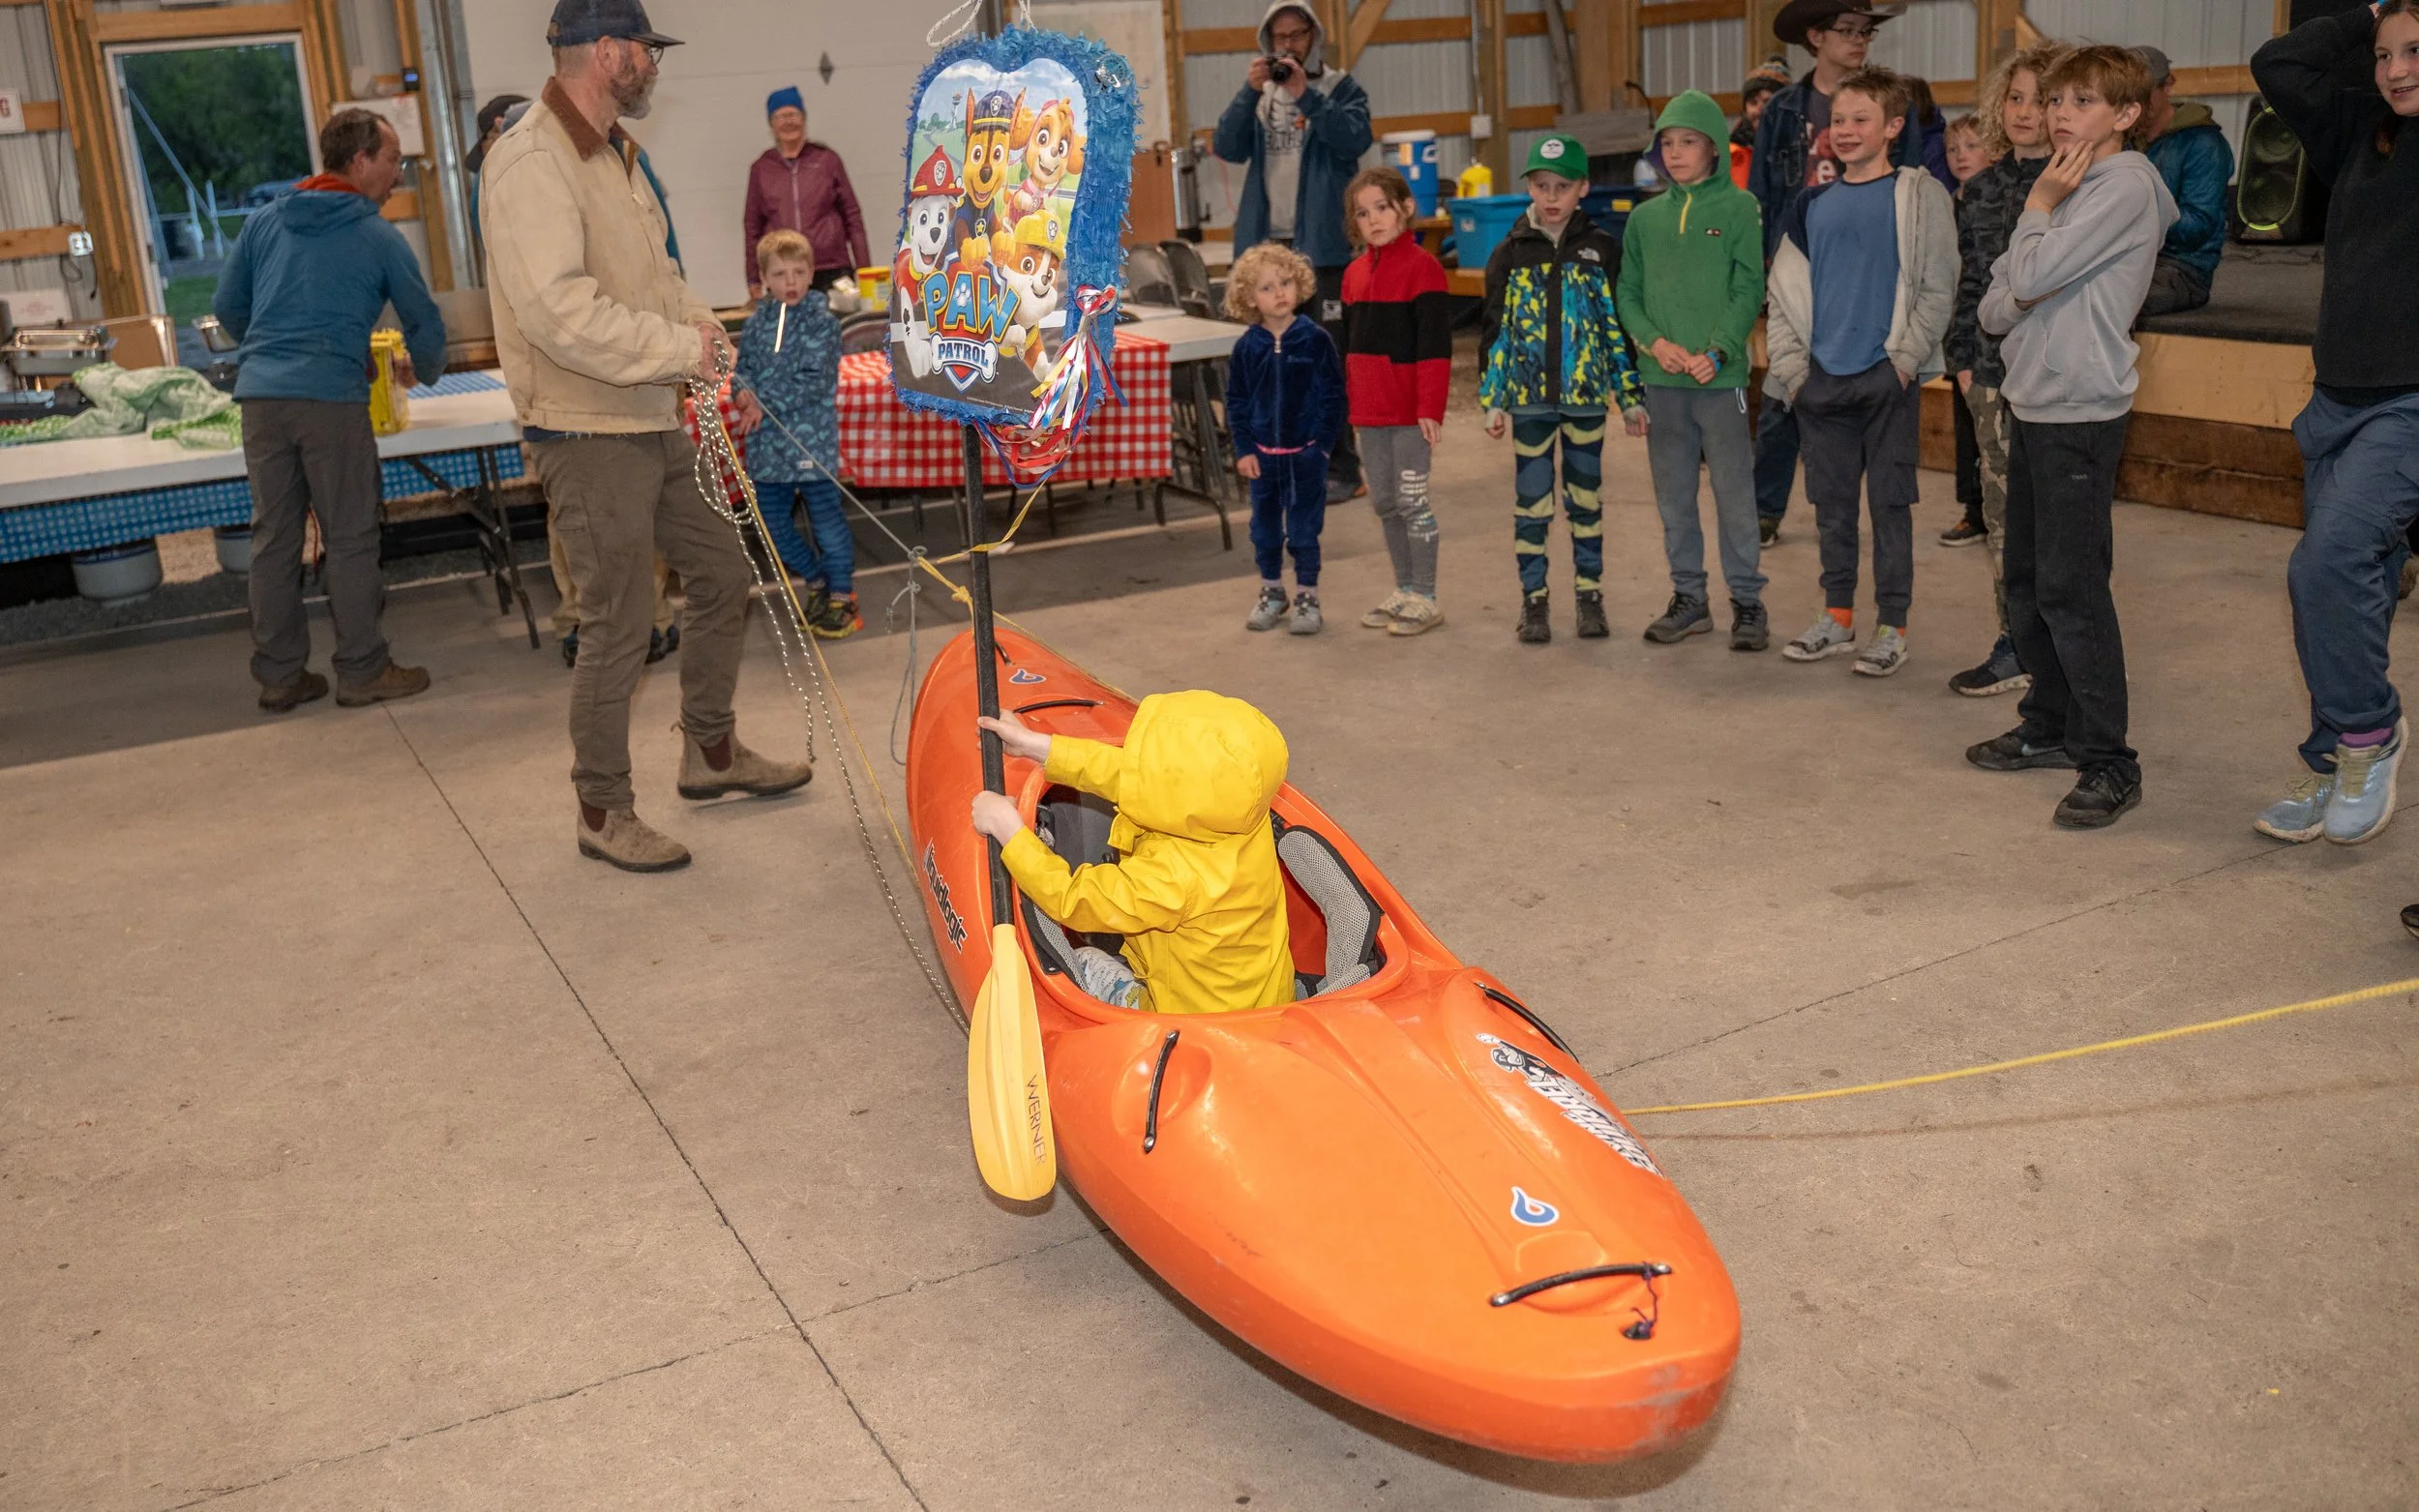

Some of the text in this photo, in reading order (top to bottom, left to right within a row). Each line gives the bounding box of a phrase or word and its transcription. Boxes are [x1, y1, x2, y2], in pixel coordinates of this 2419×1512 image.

[923, 271, 1021, 342] PAW
[938, 341, 989, 367] PATROL
[1027, 1074, 1047, 1166] WERNER
